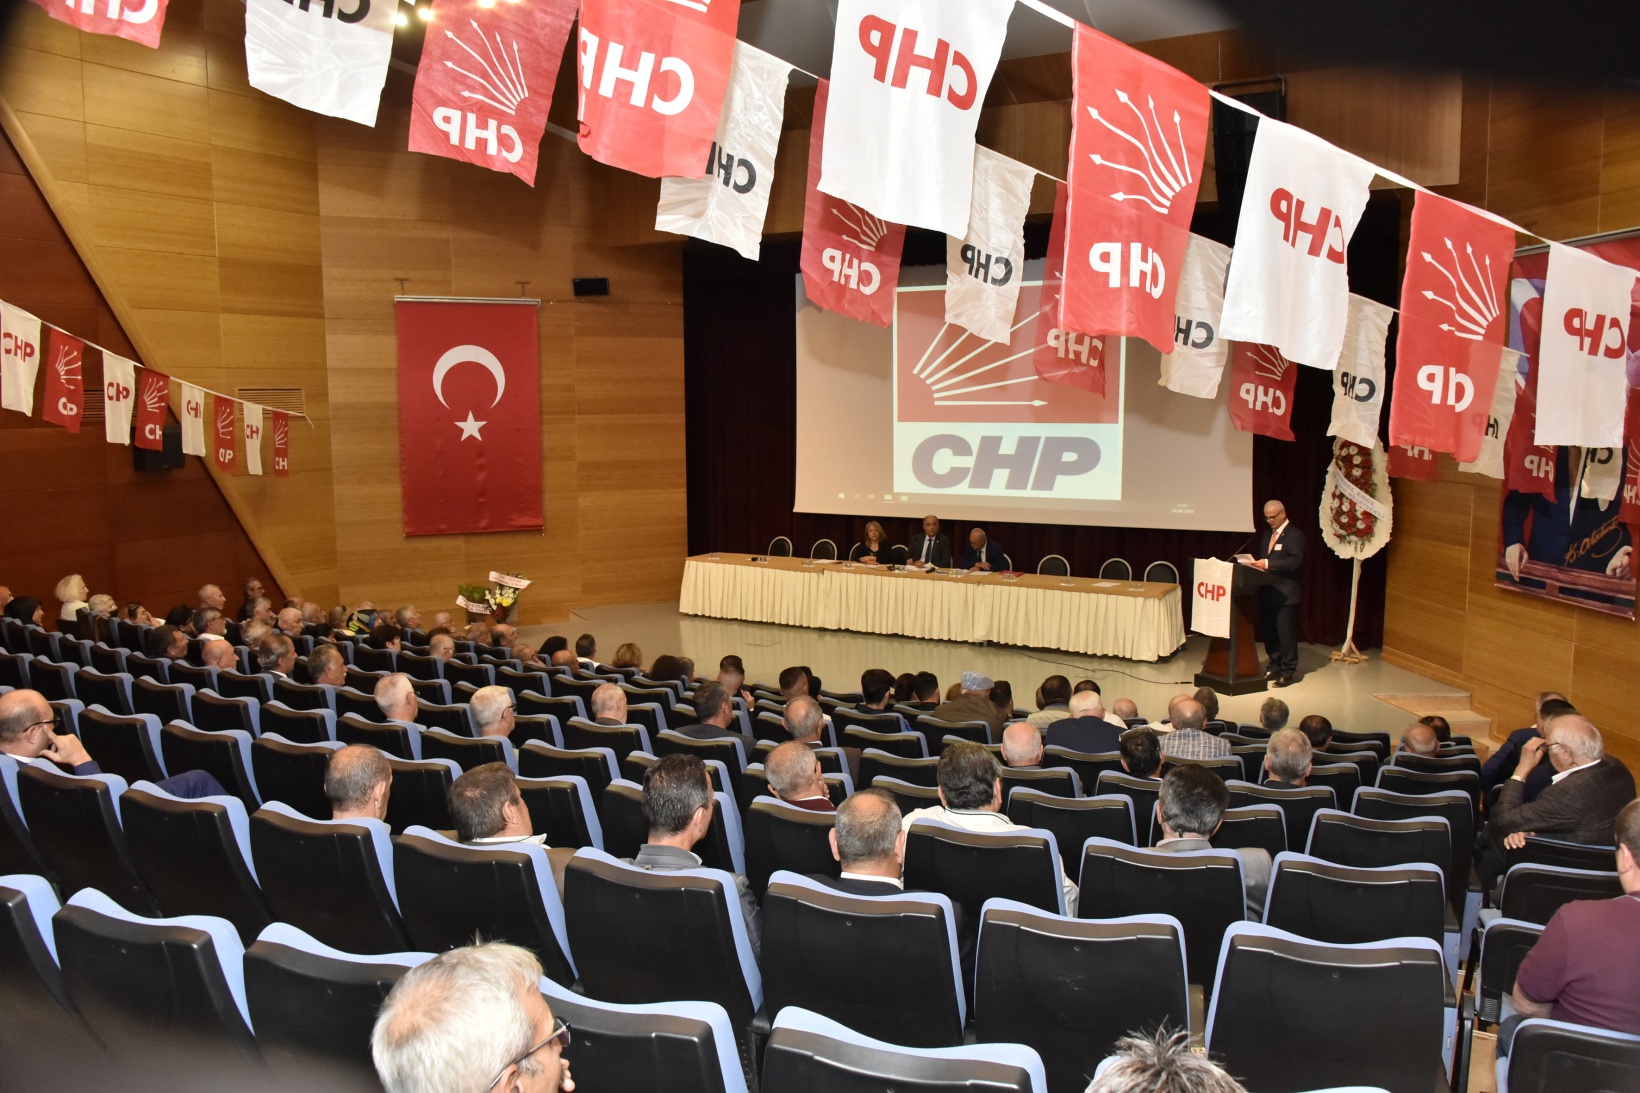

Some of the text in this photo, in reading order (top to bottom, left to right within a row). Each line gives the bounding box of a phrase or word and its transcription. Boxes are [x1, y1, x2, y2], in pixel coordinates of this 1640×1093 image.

[3, 332, 35, 363] CHP
[911, 433, 1102, 492] CHP
[1197, 581, 1227, 602] CHP
